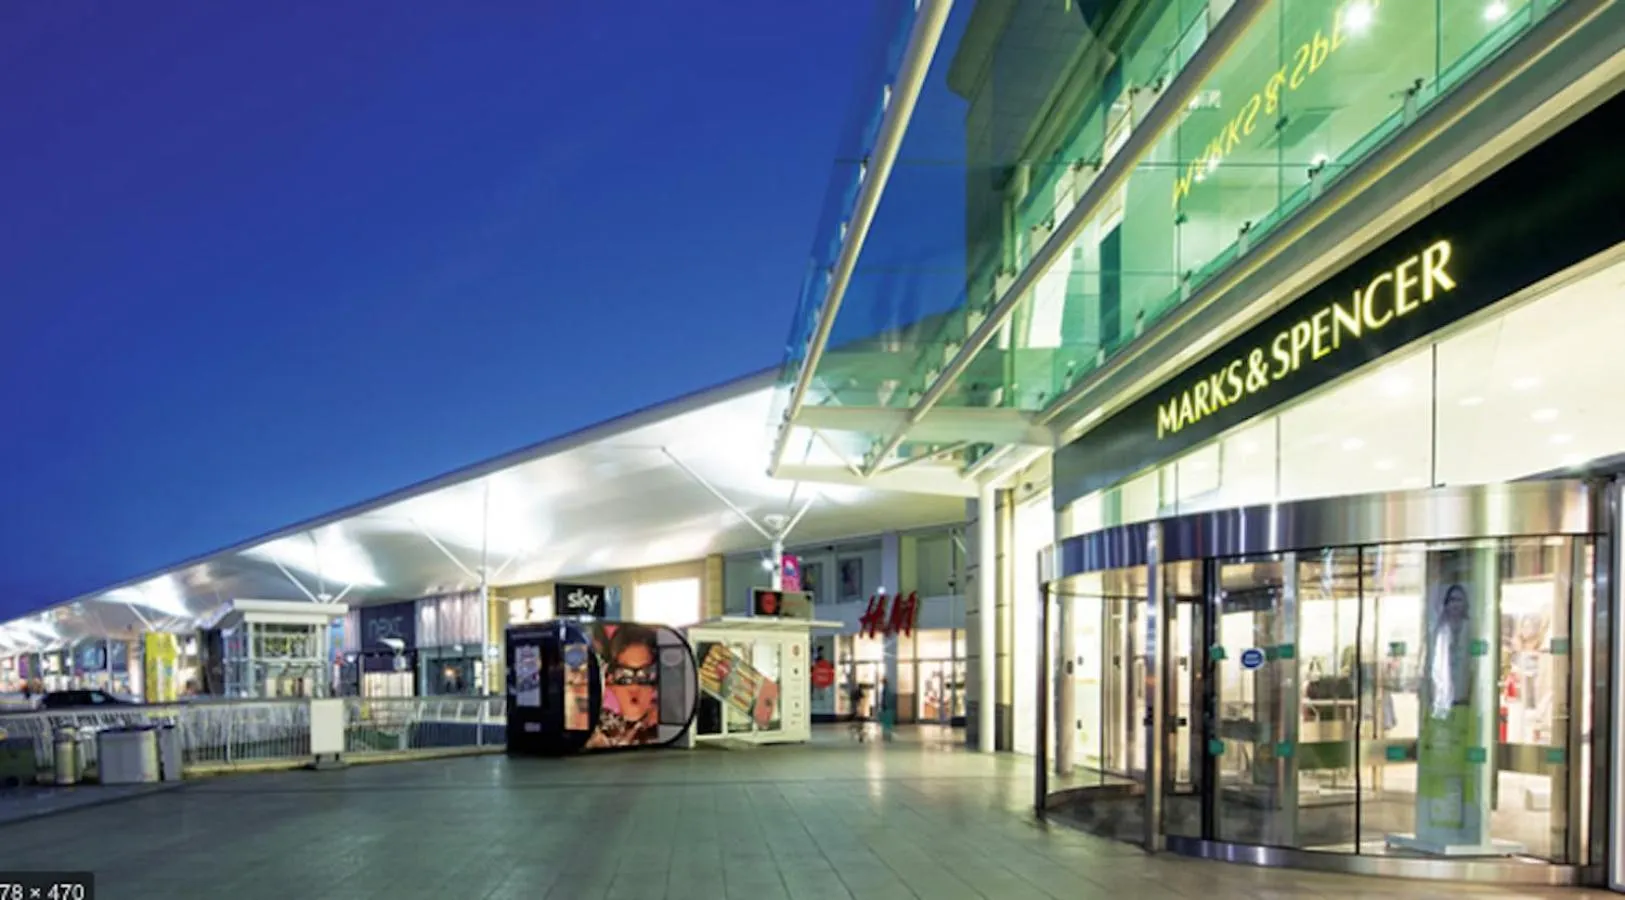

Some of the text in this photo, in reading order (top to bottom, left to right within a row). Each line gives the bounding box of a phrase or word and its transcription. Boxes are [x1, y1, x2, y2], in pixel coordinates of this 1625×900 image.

[1156, 239, 1456, 440] MARKS & SPENCER
[567, 588, 599, 613] sky
